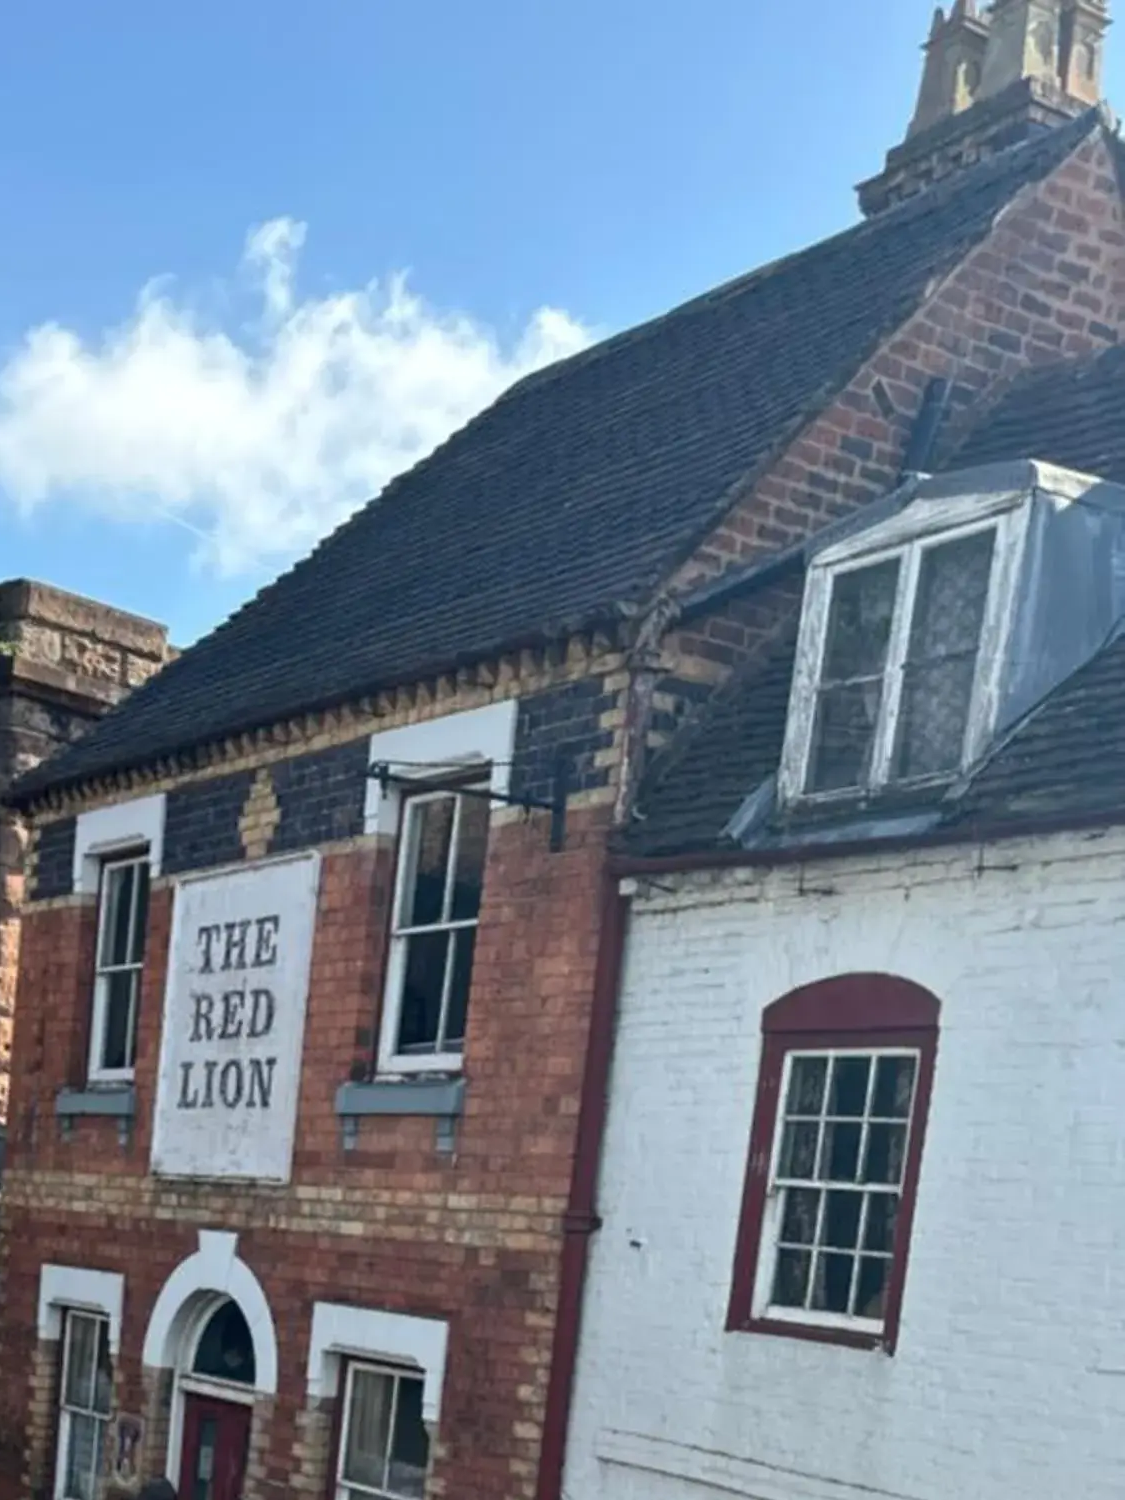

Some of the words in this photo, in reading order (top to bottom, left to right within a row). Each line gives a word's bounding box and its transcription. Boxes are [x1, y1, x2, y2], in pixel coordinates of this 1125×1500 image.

[197, 914, 281, 975] THE
[188, 987, 276, 1043] RED
[176, 1057, 278, 1110] LION
